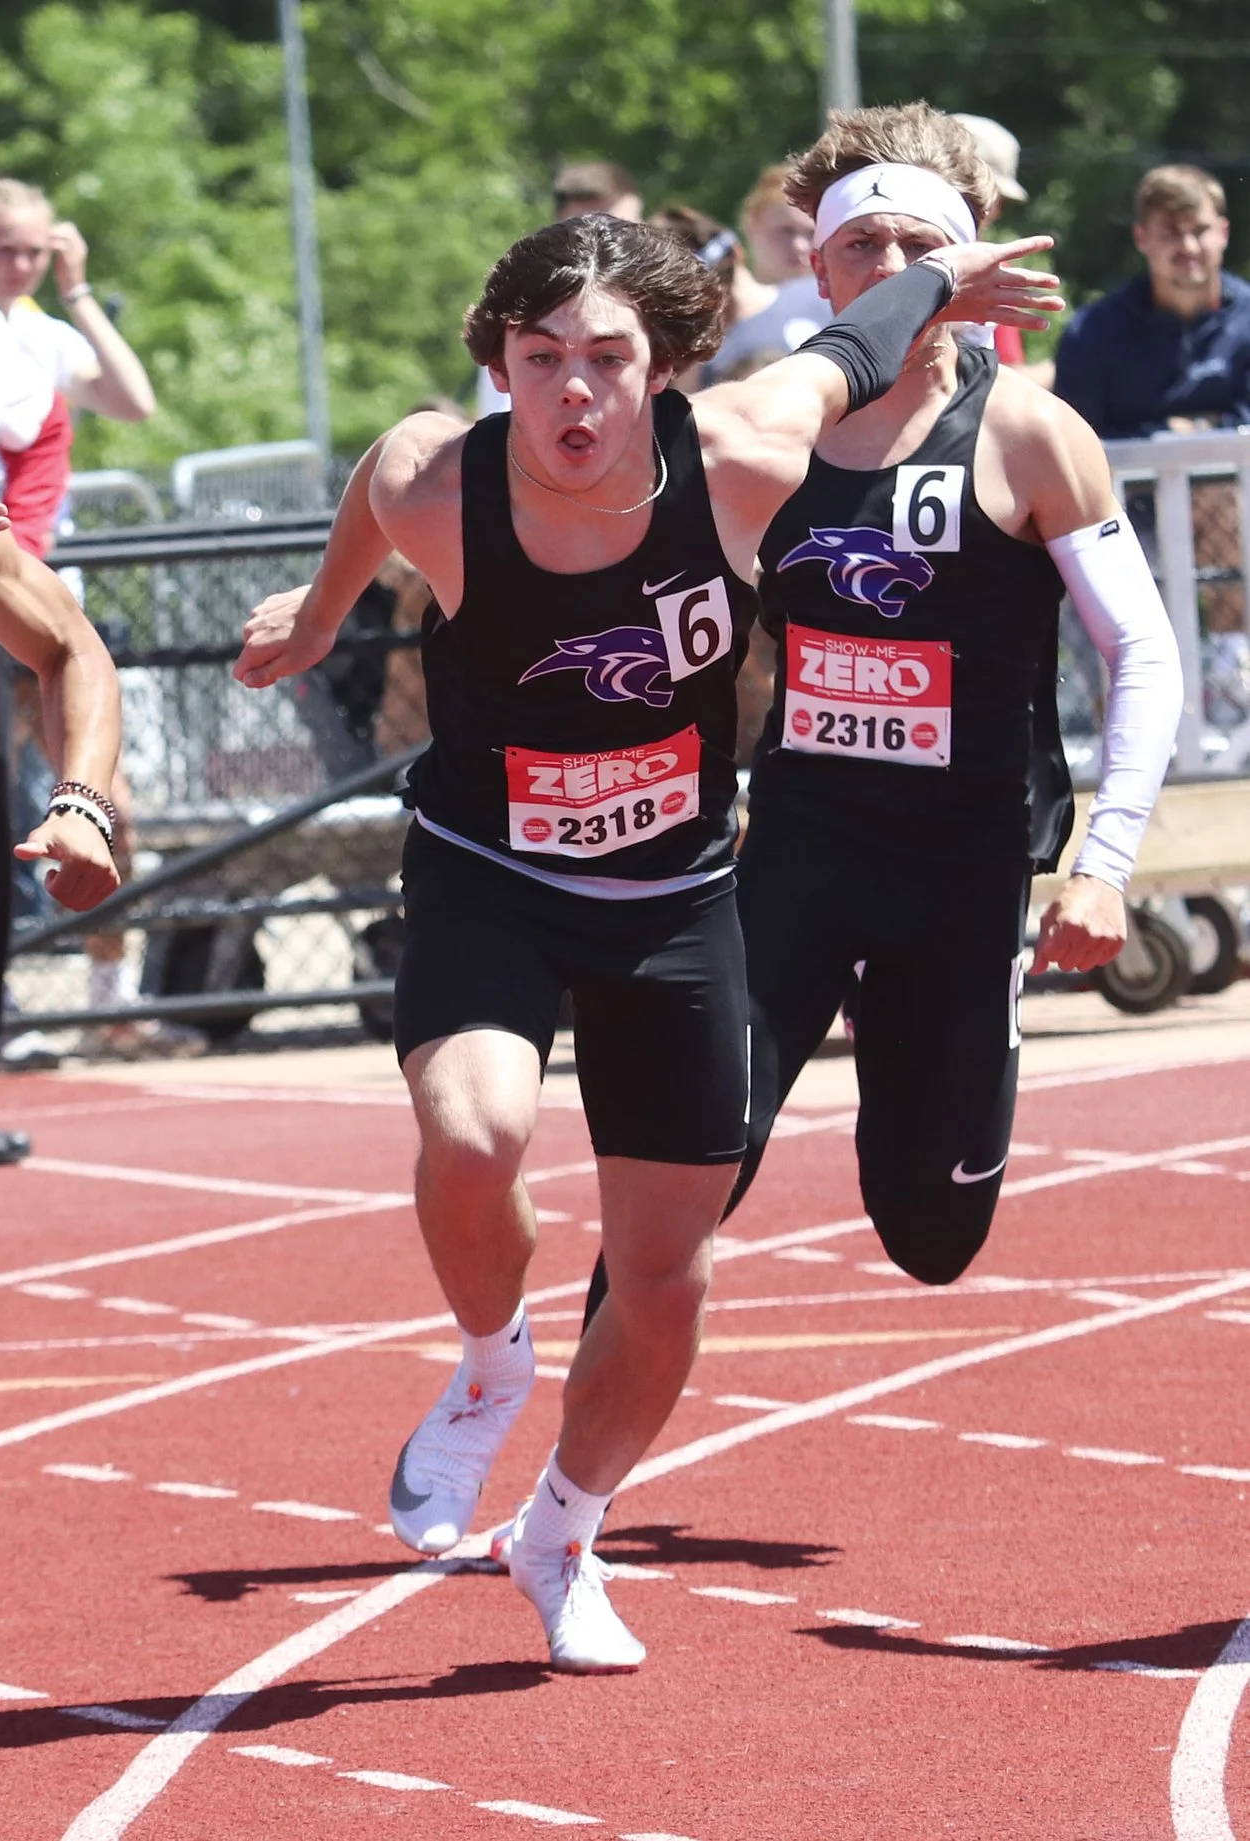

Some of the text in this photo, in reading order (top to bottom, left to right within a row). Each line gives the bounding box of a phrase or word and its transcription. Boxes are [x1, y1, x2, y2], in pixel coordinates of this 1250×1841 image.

[907, 470, 947, 546] 6
[678, 589, 721, 667] 6
[824, 639, 898, 660] SHOW-ME
[799, 646, 930, 697] ZERO
[816, 711, 906, 751] 2316
[526, 751, 679, 800] ZERO
[562, 749, 646, 769] SHOW-ME
[558, 798, 656, 845] 2318
